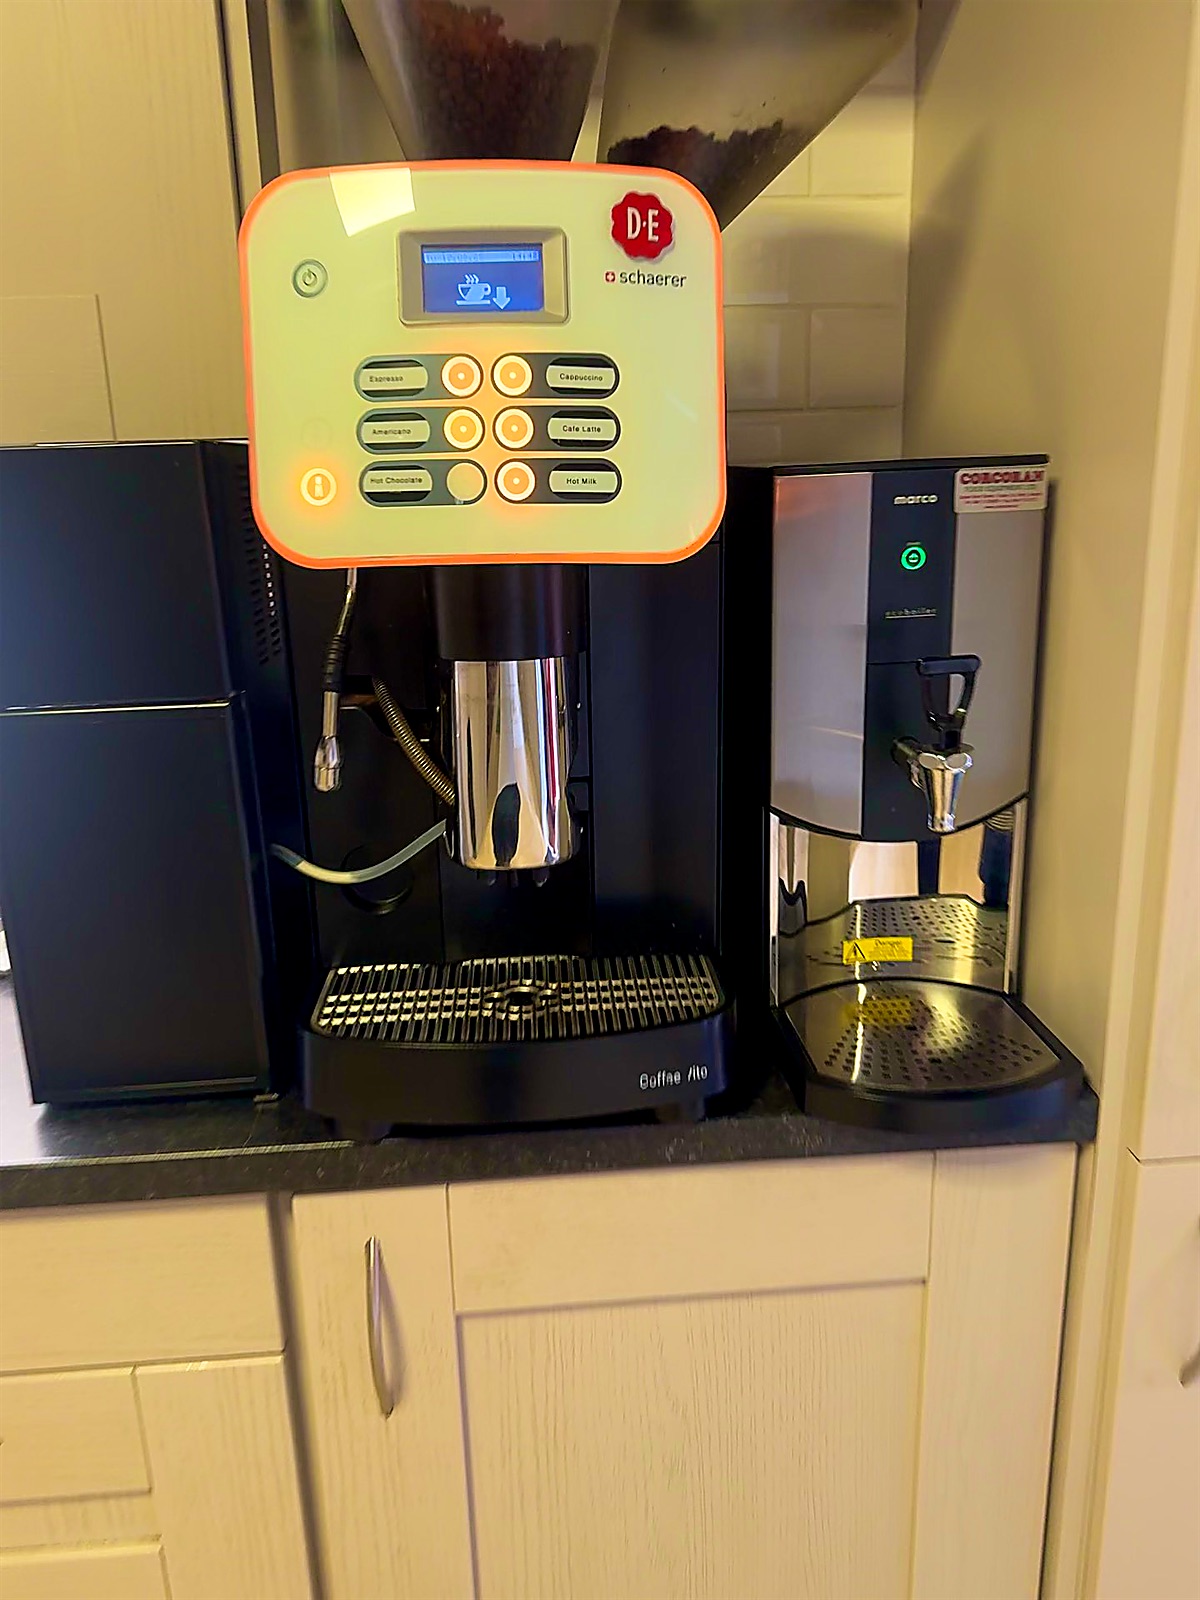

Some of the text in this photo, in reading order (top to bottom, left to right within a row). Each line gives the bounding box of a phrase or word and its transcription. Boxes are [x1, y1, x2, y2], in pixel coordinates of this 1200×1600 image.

[619, 269, 687, 287] schaerer
[559, 372, 603, 381] Cappuccino
[562, 425, 580, 433] Cafe
[385, 476, 423, 484] Chocolate
[960, 470, 1045, 485] CORCORAN
[893, 494, 938, 505] marco
